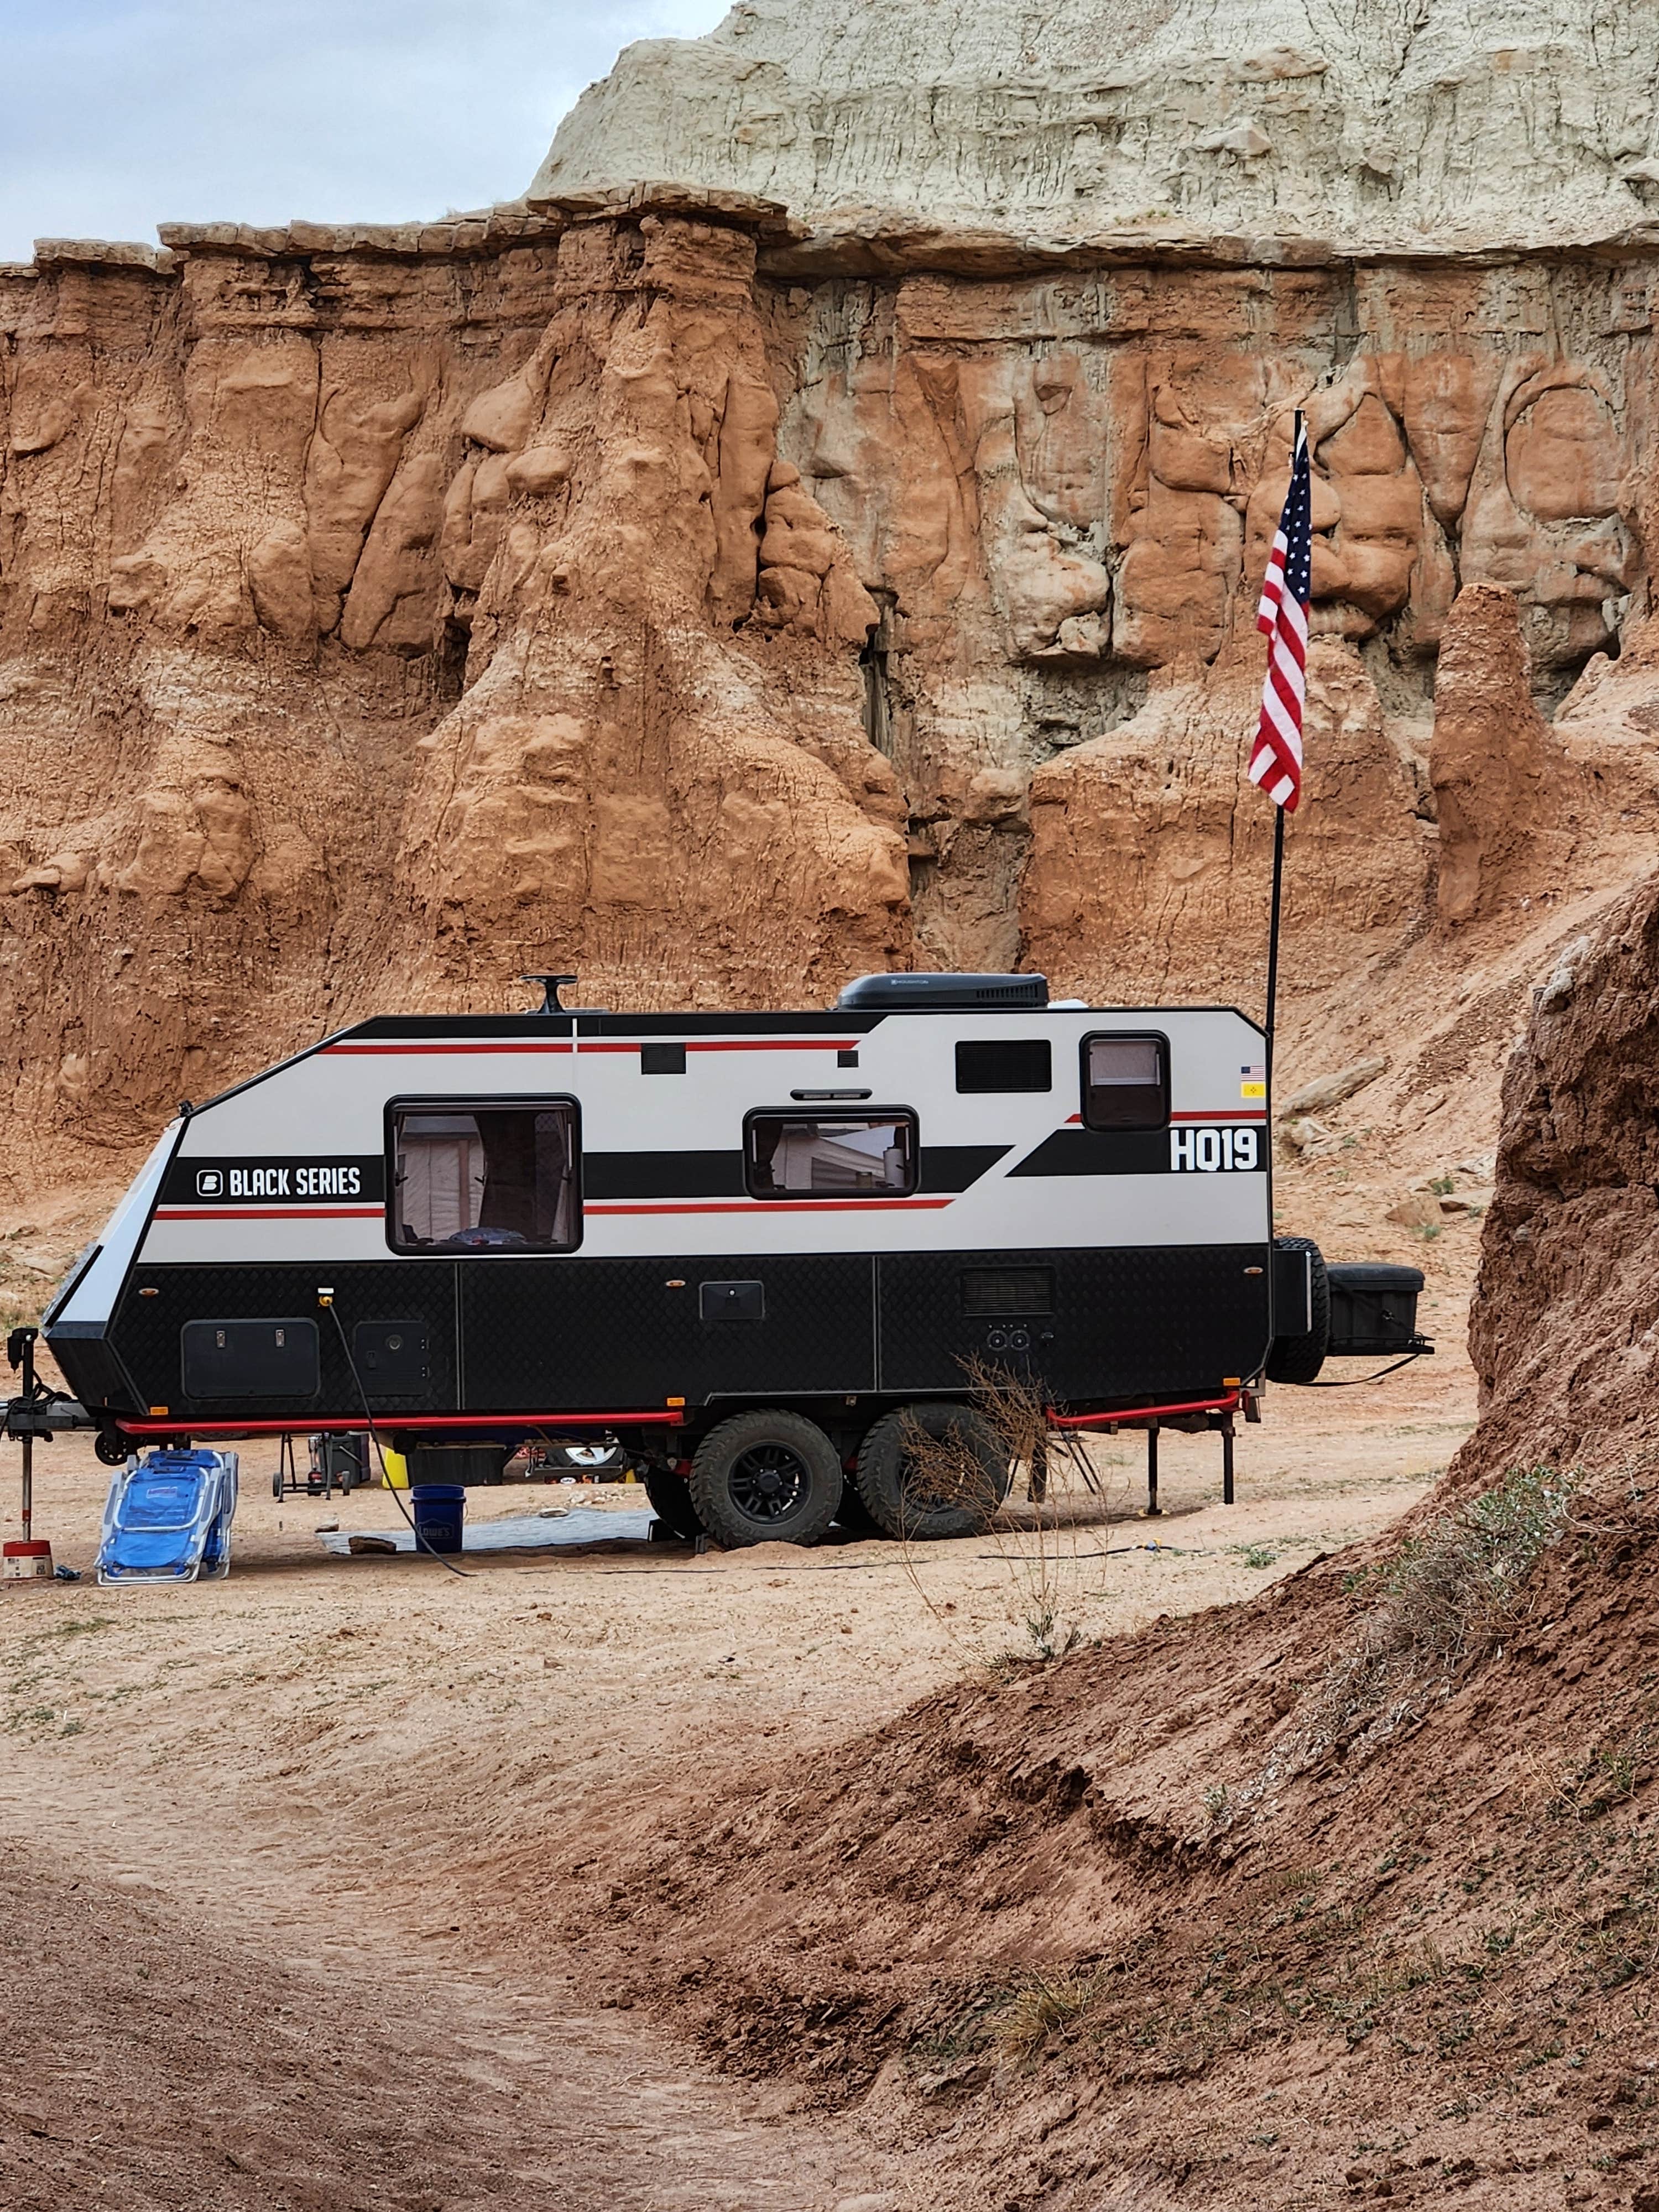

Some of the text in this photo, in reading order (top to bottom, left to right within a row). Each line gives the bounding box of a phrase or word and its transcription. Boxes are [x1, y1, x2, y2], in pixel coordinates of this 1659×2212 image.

[1171, 1129, 1257, 1171] HQ19
[230, 1167, 359, 1196] BLACK SERIES
